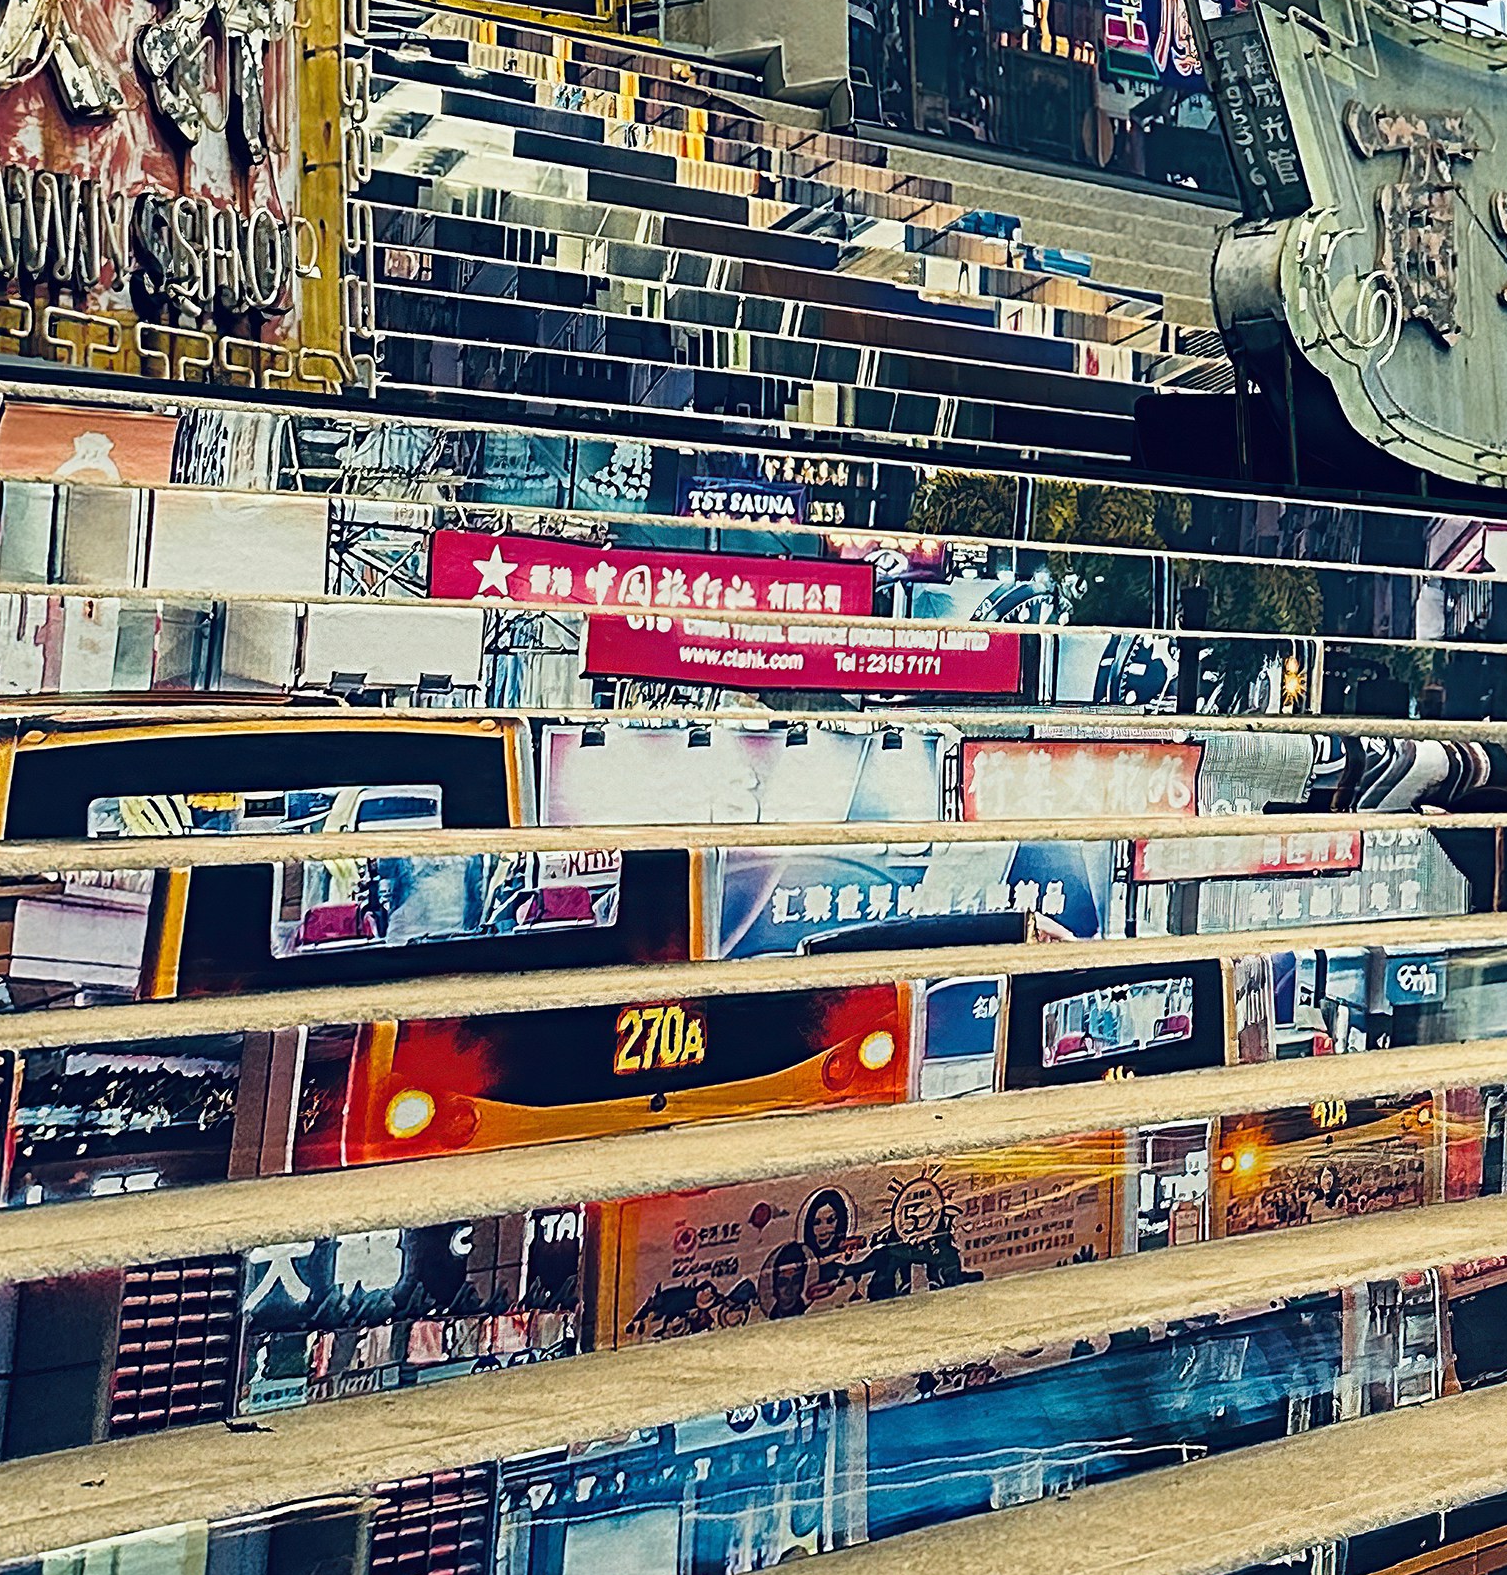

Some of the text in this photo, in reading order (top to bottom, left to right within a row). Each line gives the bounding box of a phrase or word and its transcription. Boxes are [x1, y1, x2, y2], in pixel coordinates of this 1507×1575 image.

[134, 189, 317, 315] SHOP
[688, 490, 727, 512] TST
[730, 492, 796, 516] SAUNA
[616, 1005, 706, 1074] 270A
